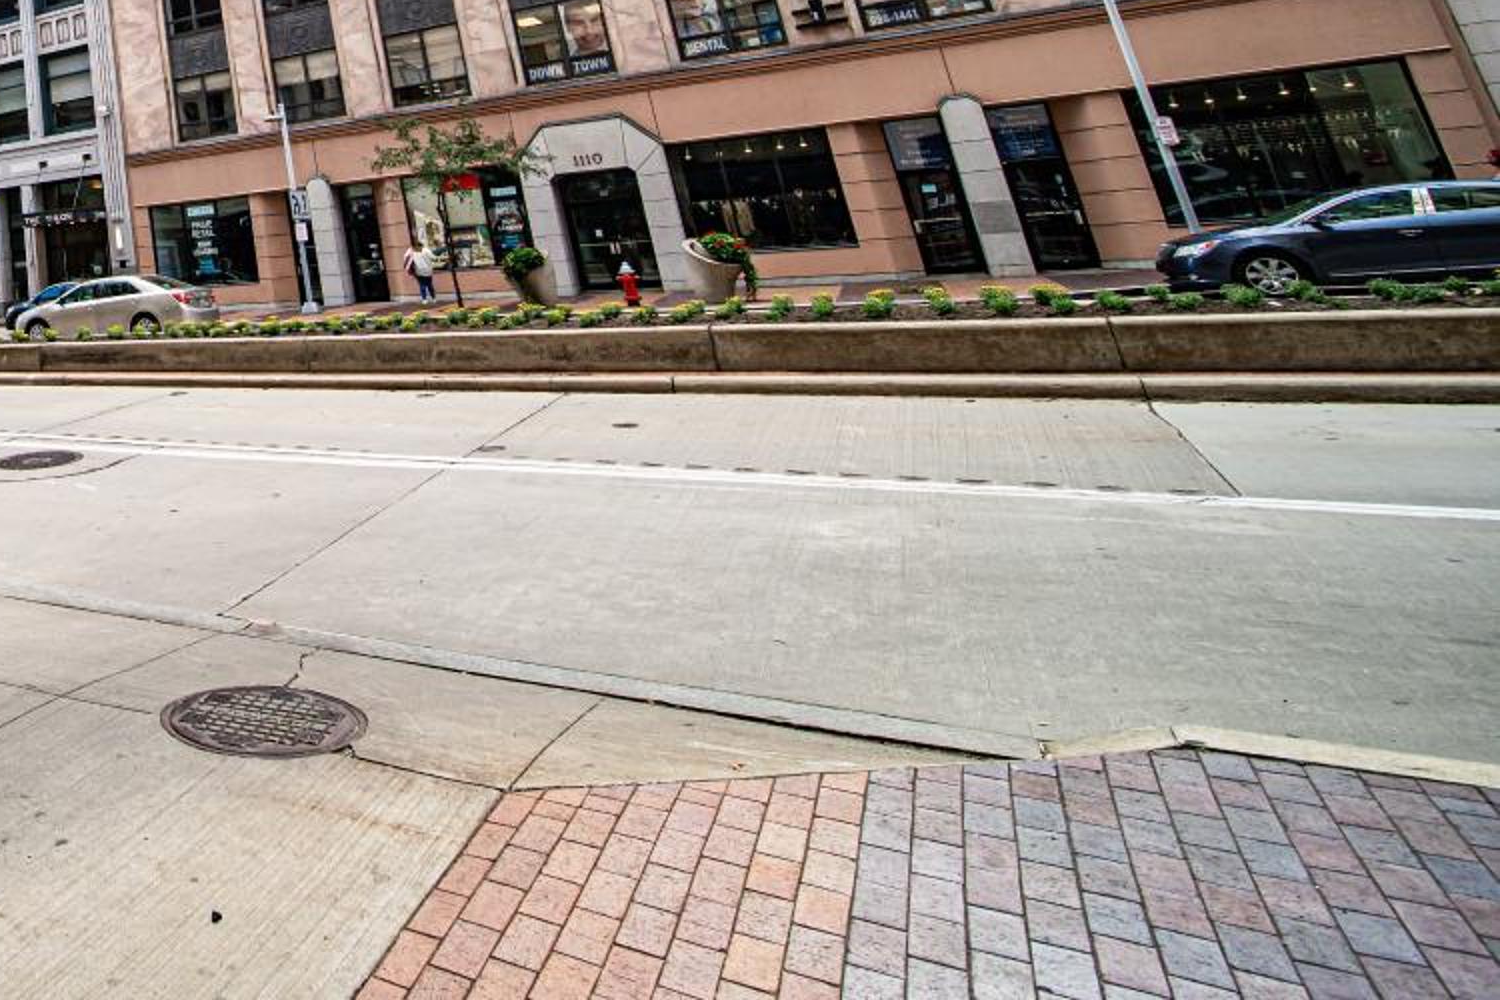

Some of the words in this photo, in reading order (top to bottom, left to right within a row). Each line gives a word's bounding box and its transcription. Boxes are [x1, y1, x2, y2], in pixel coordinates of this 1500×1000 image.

[529, 61, 567, 80] DOWN
[572, 57, 610, 73] TOWN
[573, 153, 603, 167] 1110
